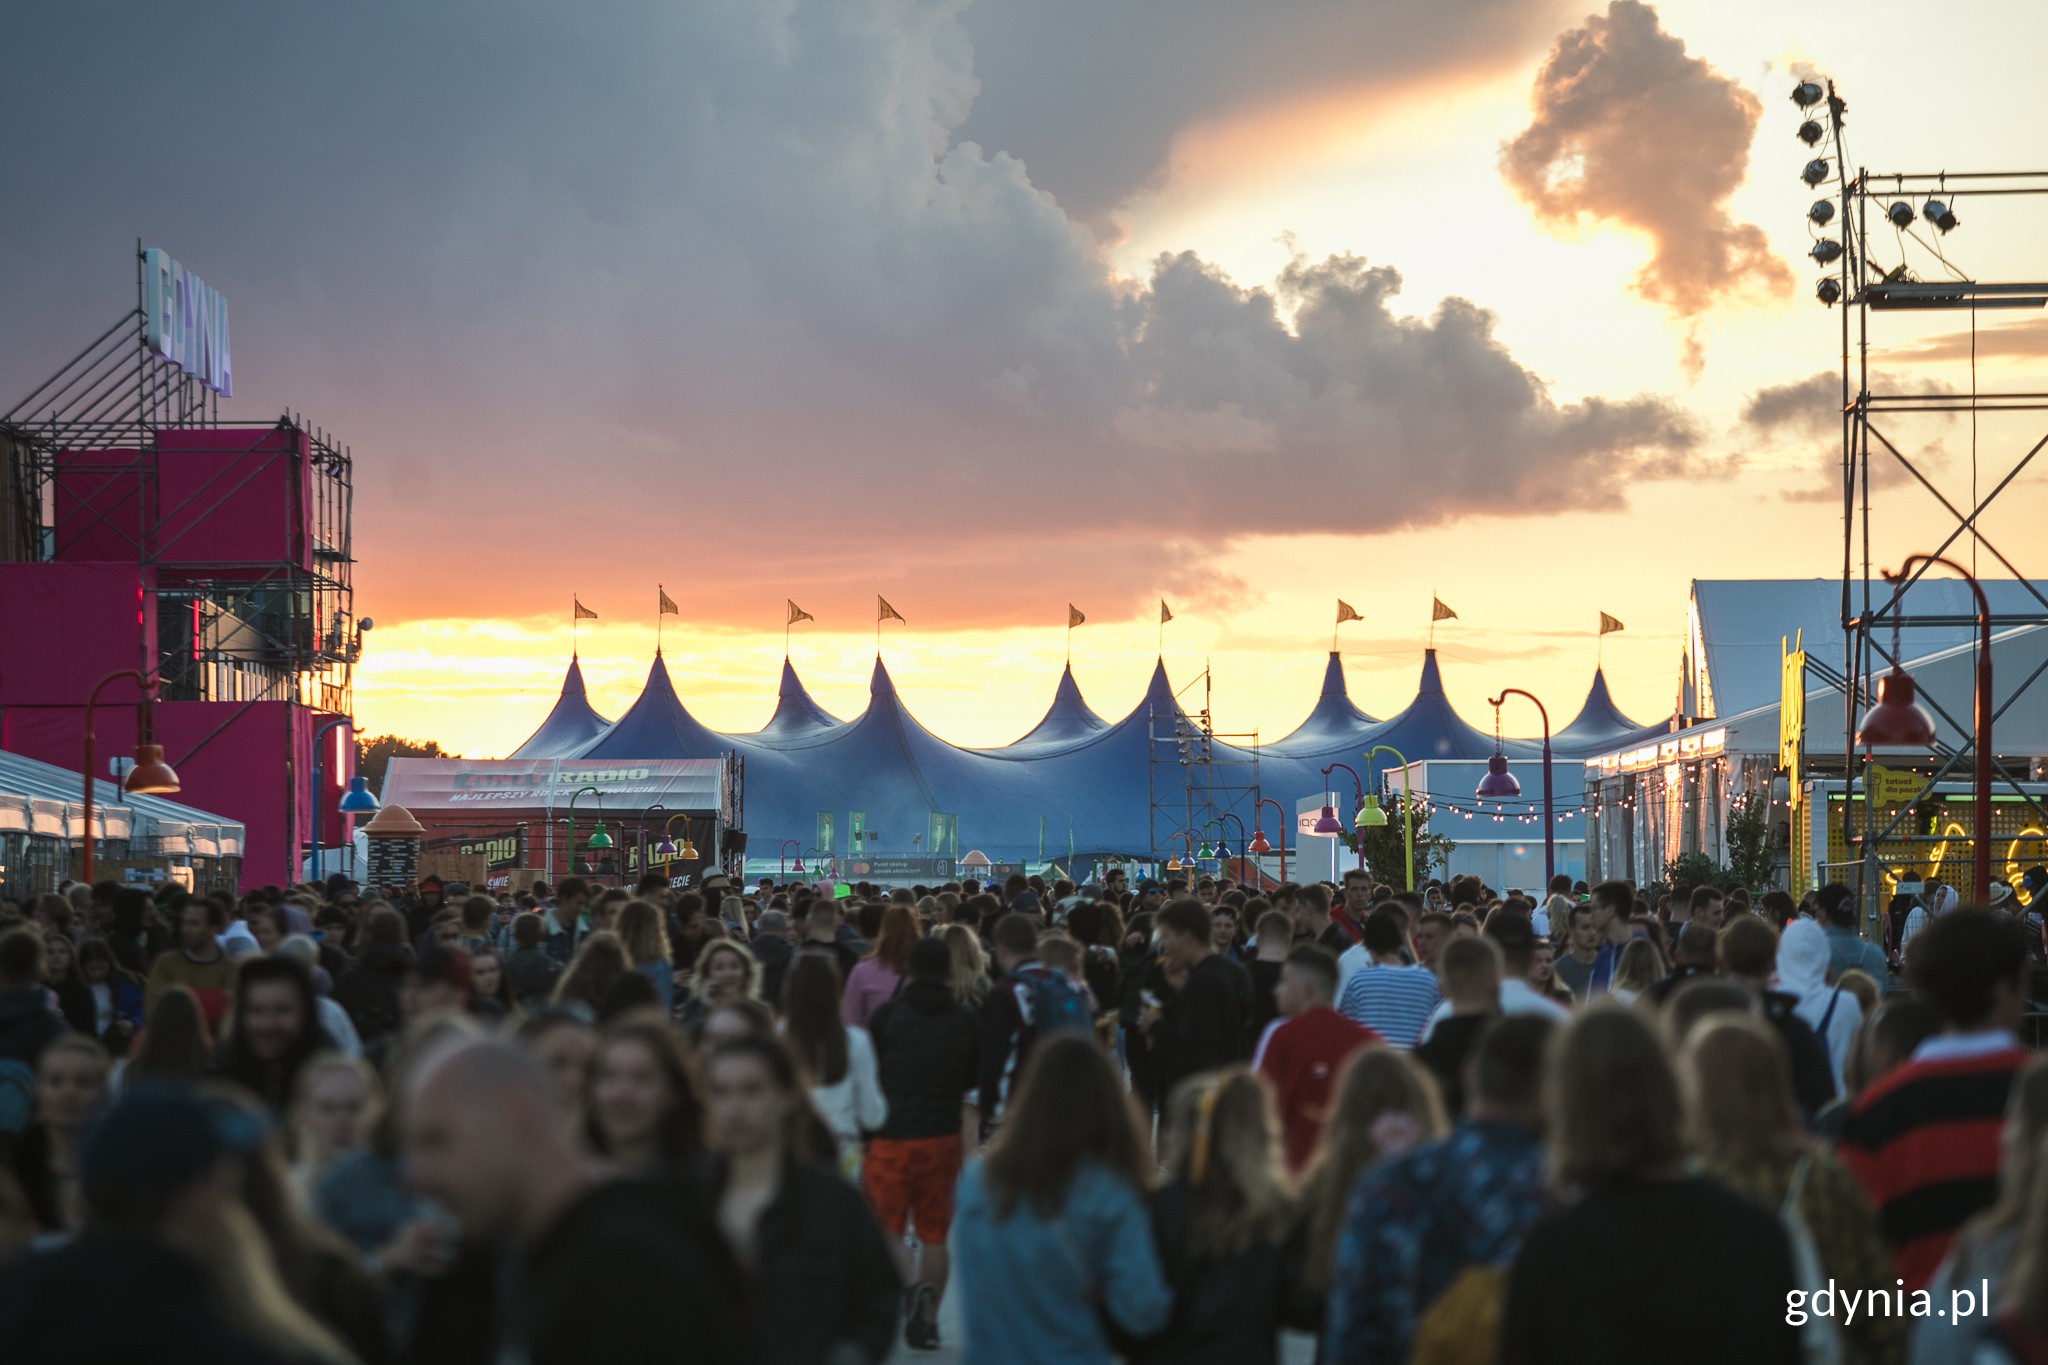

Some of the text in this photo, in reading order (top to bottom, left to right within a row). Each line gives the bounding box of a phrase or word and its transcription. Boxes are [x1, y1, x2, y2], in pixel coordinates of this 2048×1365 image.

[1899, 786, 1925, 794] paczk
[449, 791, 527, 802] NAJLEPSZY
[1299, 818, 1318, 827] IQO
